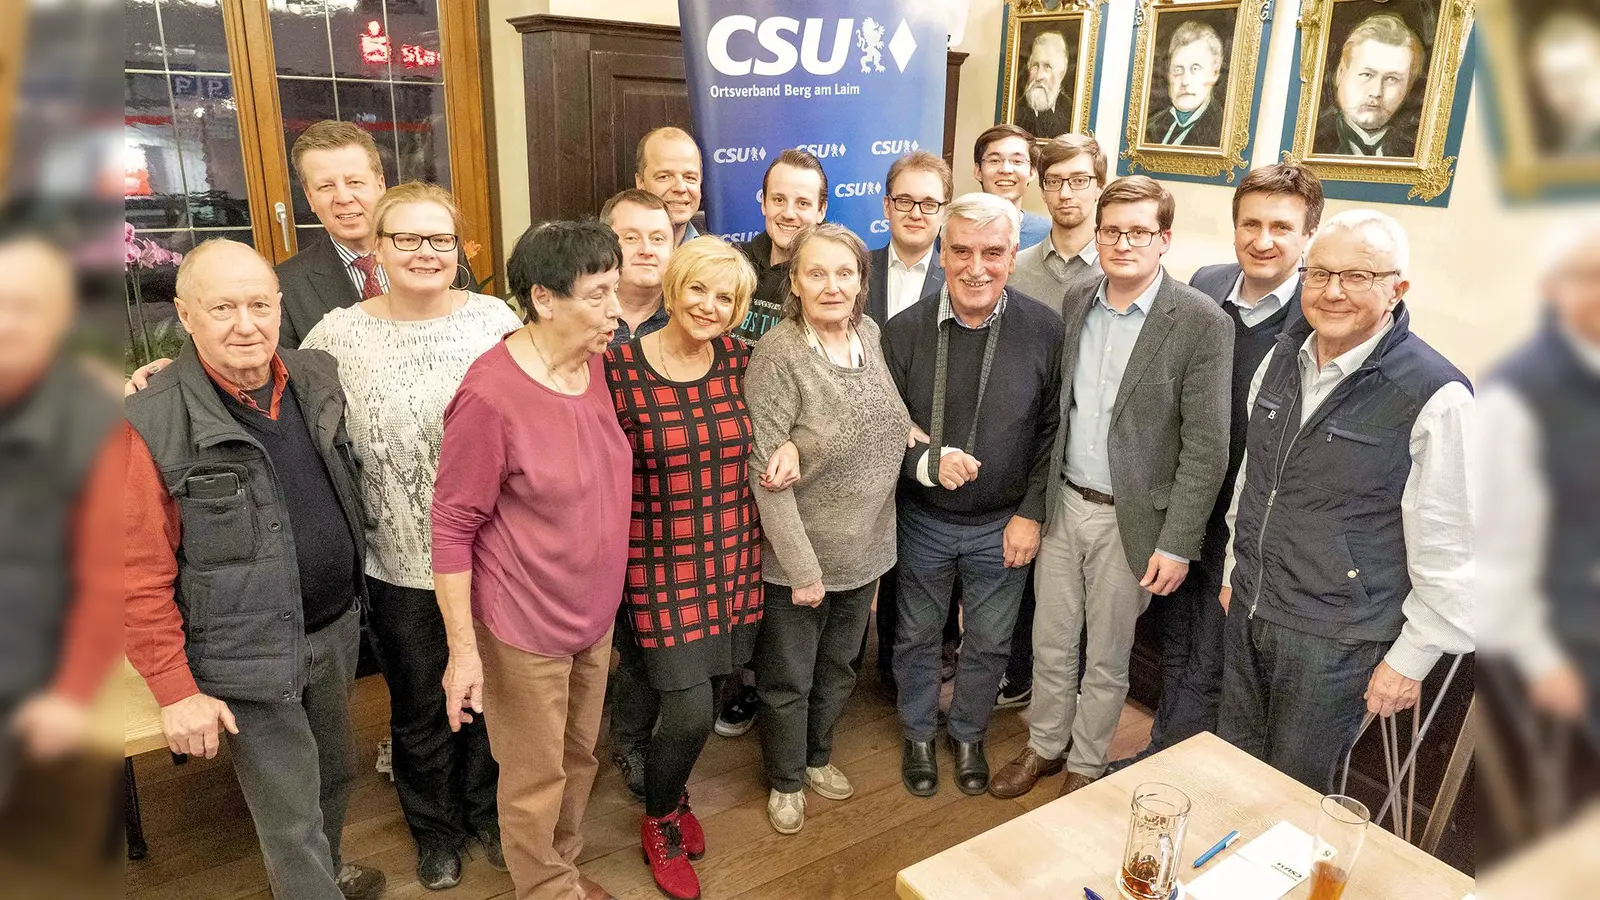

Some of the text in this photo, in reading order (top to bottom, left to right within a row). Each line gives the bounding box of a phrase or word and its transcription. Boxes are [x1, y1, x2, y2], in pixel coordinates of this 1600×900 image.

[706, 14, 854, 76] CSU
[710, 83, 860, 98] Ortsverband Berg am Laim
[871, 140, 904, 155] CSU
[713, 147, 750, 164] CSU
[834, 183, 867, 198] CSU
[870, 219, 890, 234] CS
